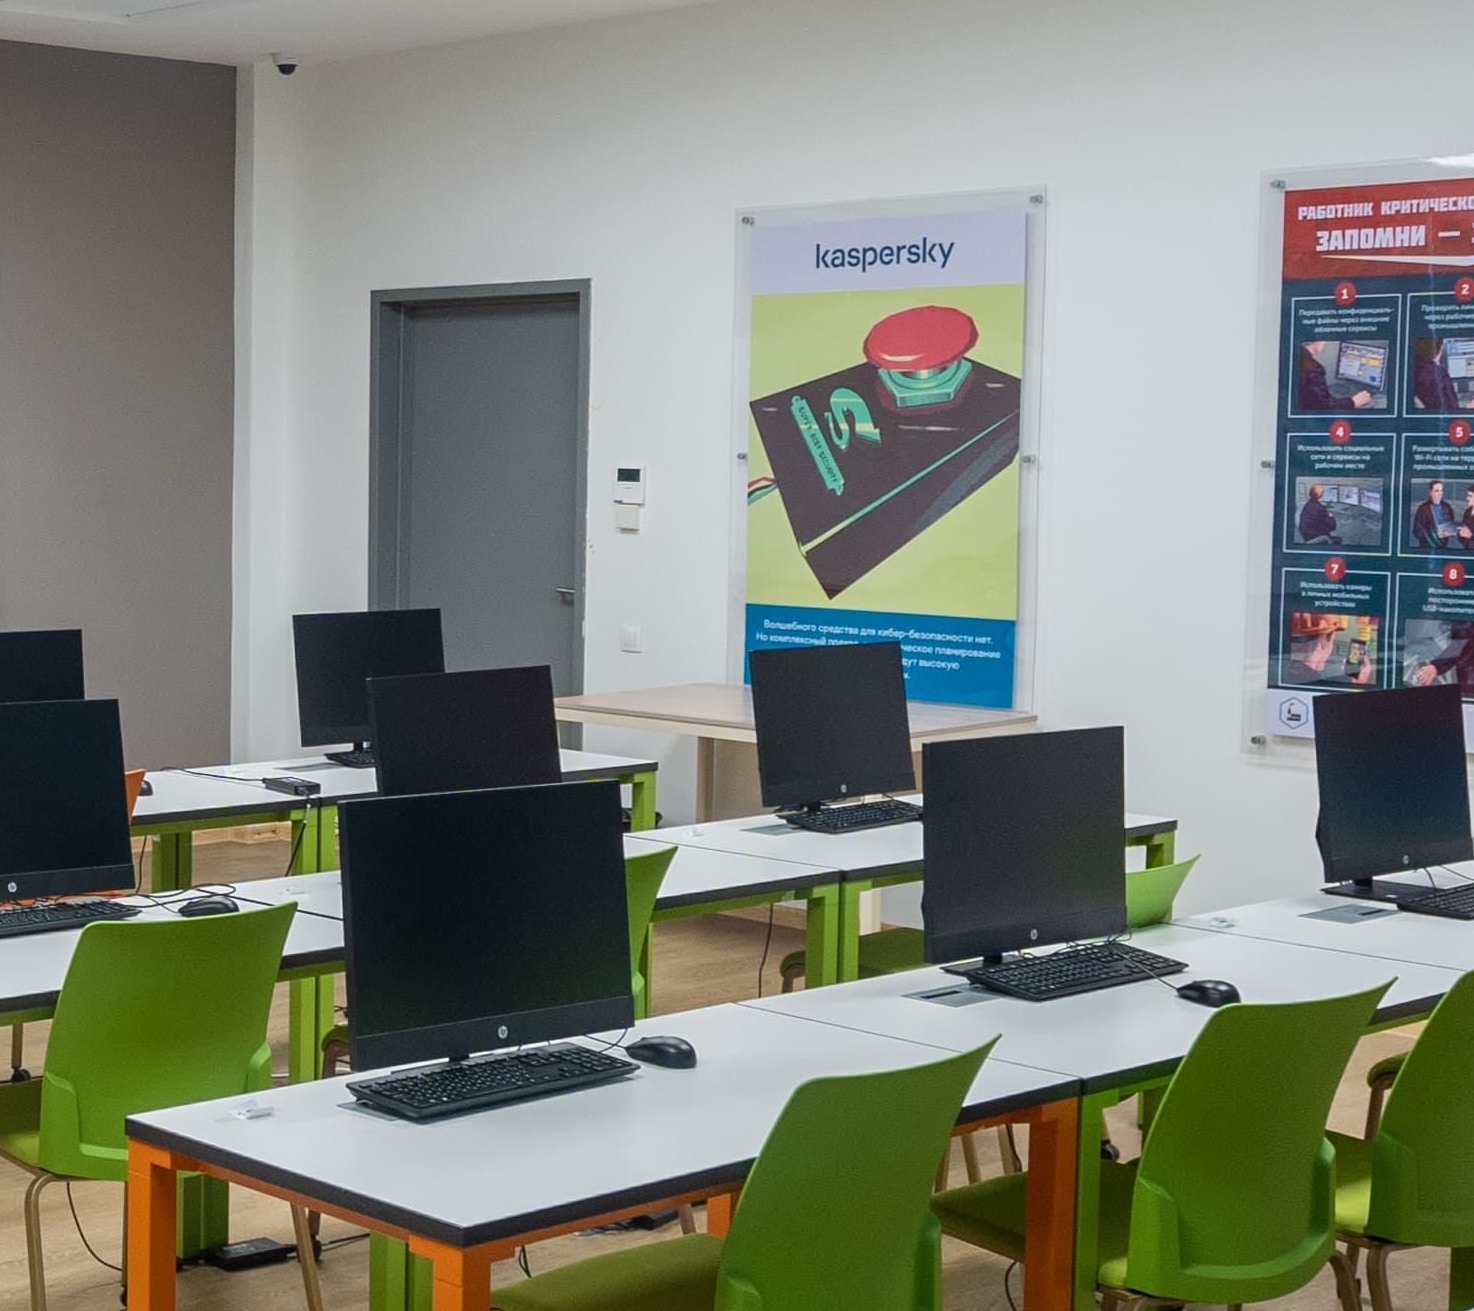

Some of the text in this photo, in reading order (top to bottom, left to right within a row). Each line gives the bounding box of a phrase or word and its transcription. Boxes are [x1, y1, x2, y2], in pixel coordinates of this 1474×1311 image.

[1297, 202, 1374, 221] РАБОТНИК
[1315, 225, 1426, 252] ЗАПОМНИ
[815, 236, 955, 273] kaspersky
[1341, 289, 1349, 299] 1
[1460, 284, 1470, 295] 2
[1335, 426, 1345, 438] 4
[1455, 426, 1464, 438] 5
[1330, 563, 1339, 575] 7
[1449, 568, 1457, 580] 8
[763, 619, 994, 644] Волшебного средства для кибер-безопасности нет.
[756, 632, 768, 641] Но
[934, 647, 1002, 659] планирование
[918, 659, 960, 671] высокую
